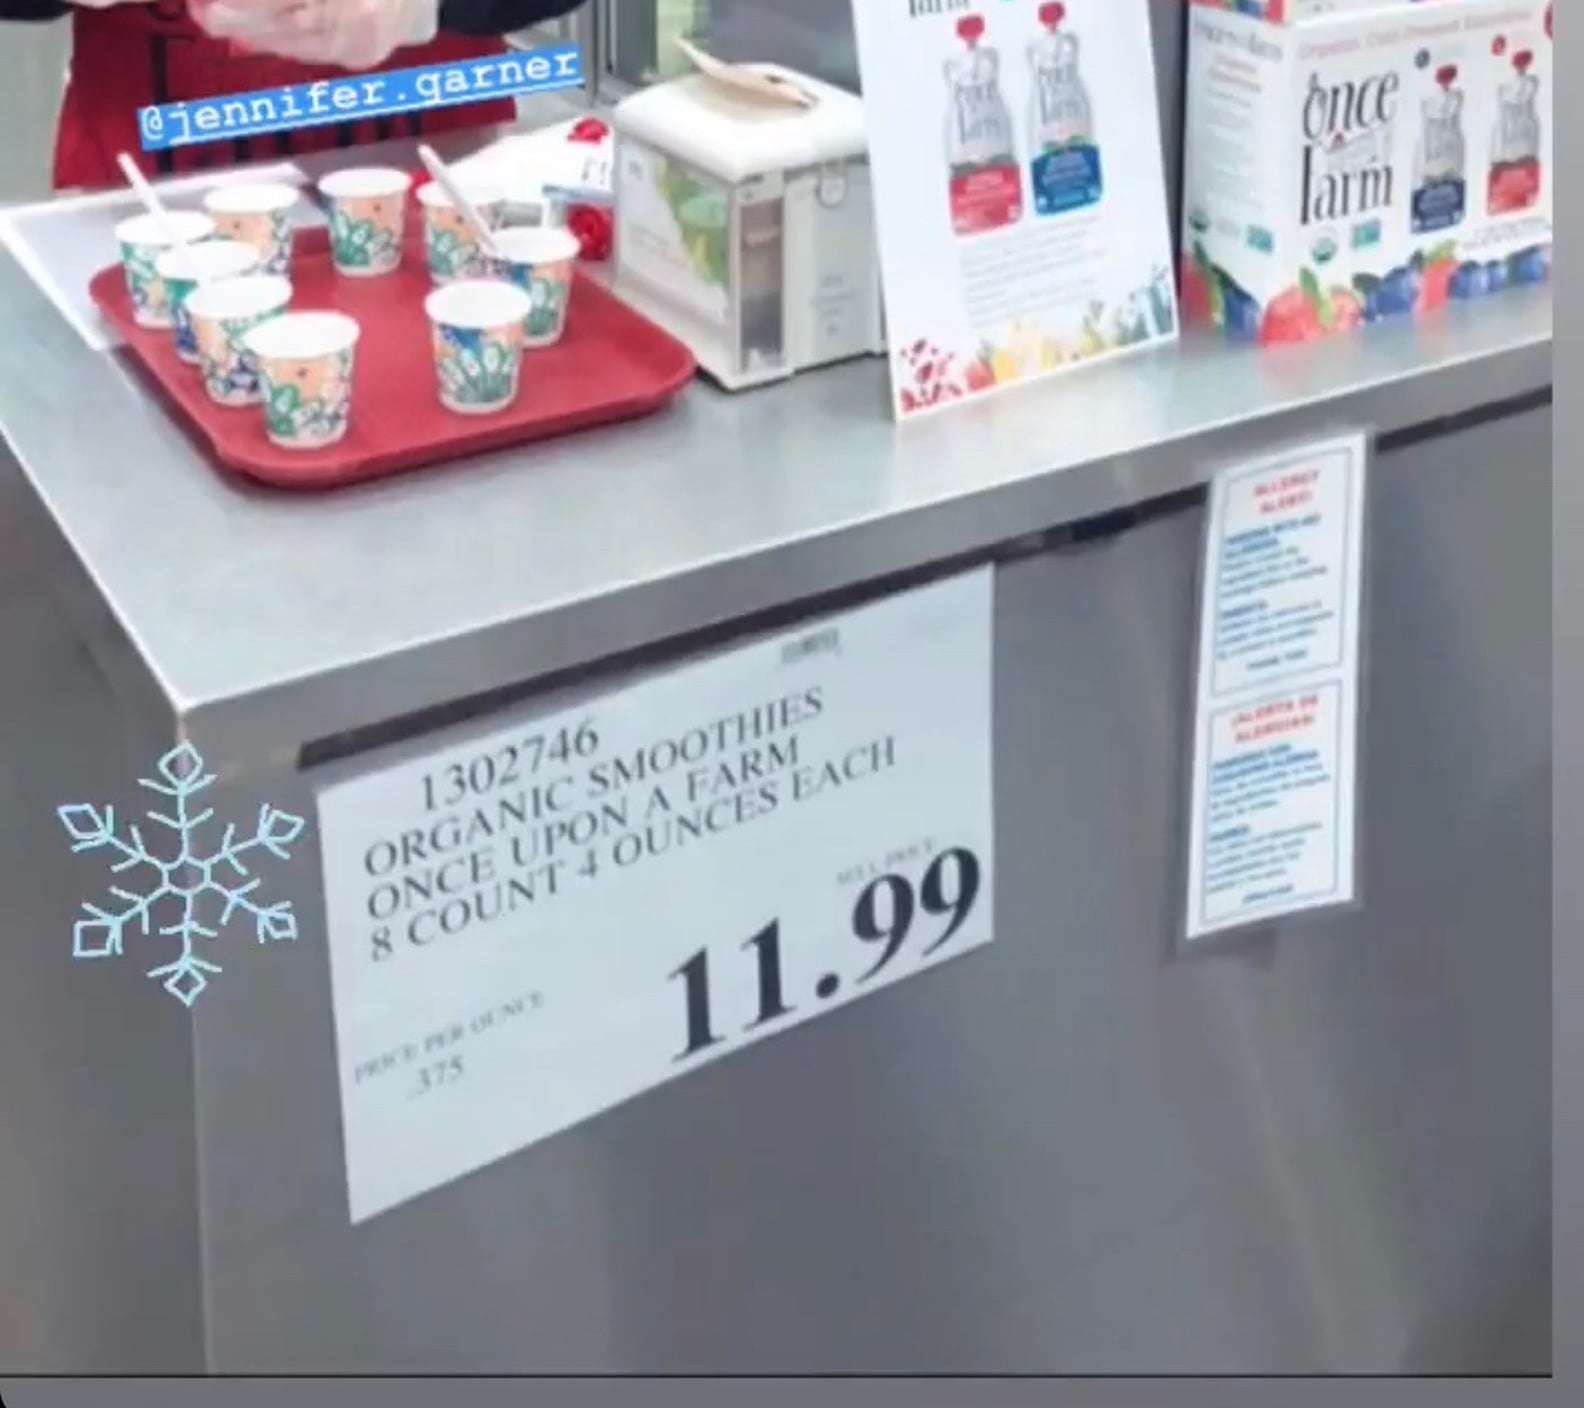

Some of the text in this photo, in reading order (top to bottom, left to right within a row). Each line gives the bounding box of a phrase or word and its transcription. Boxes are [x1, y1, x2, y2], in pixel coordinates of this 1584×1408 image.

[364, 686, 823, 877] ORGANIC SMOOTHIES
[367, 736, 799, 920] ONCE UPON A FARM
[371, 736, 895, 962] 8 COUNT 4 OUNCES EACH
[422, 718, 600, 811] 1302746
[667, 845, 982, 1063] 11.99
